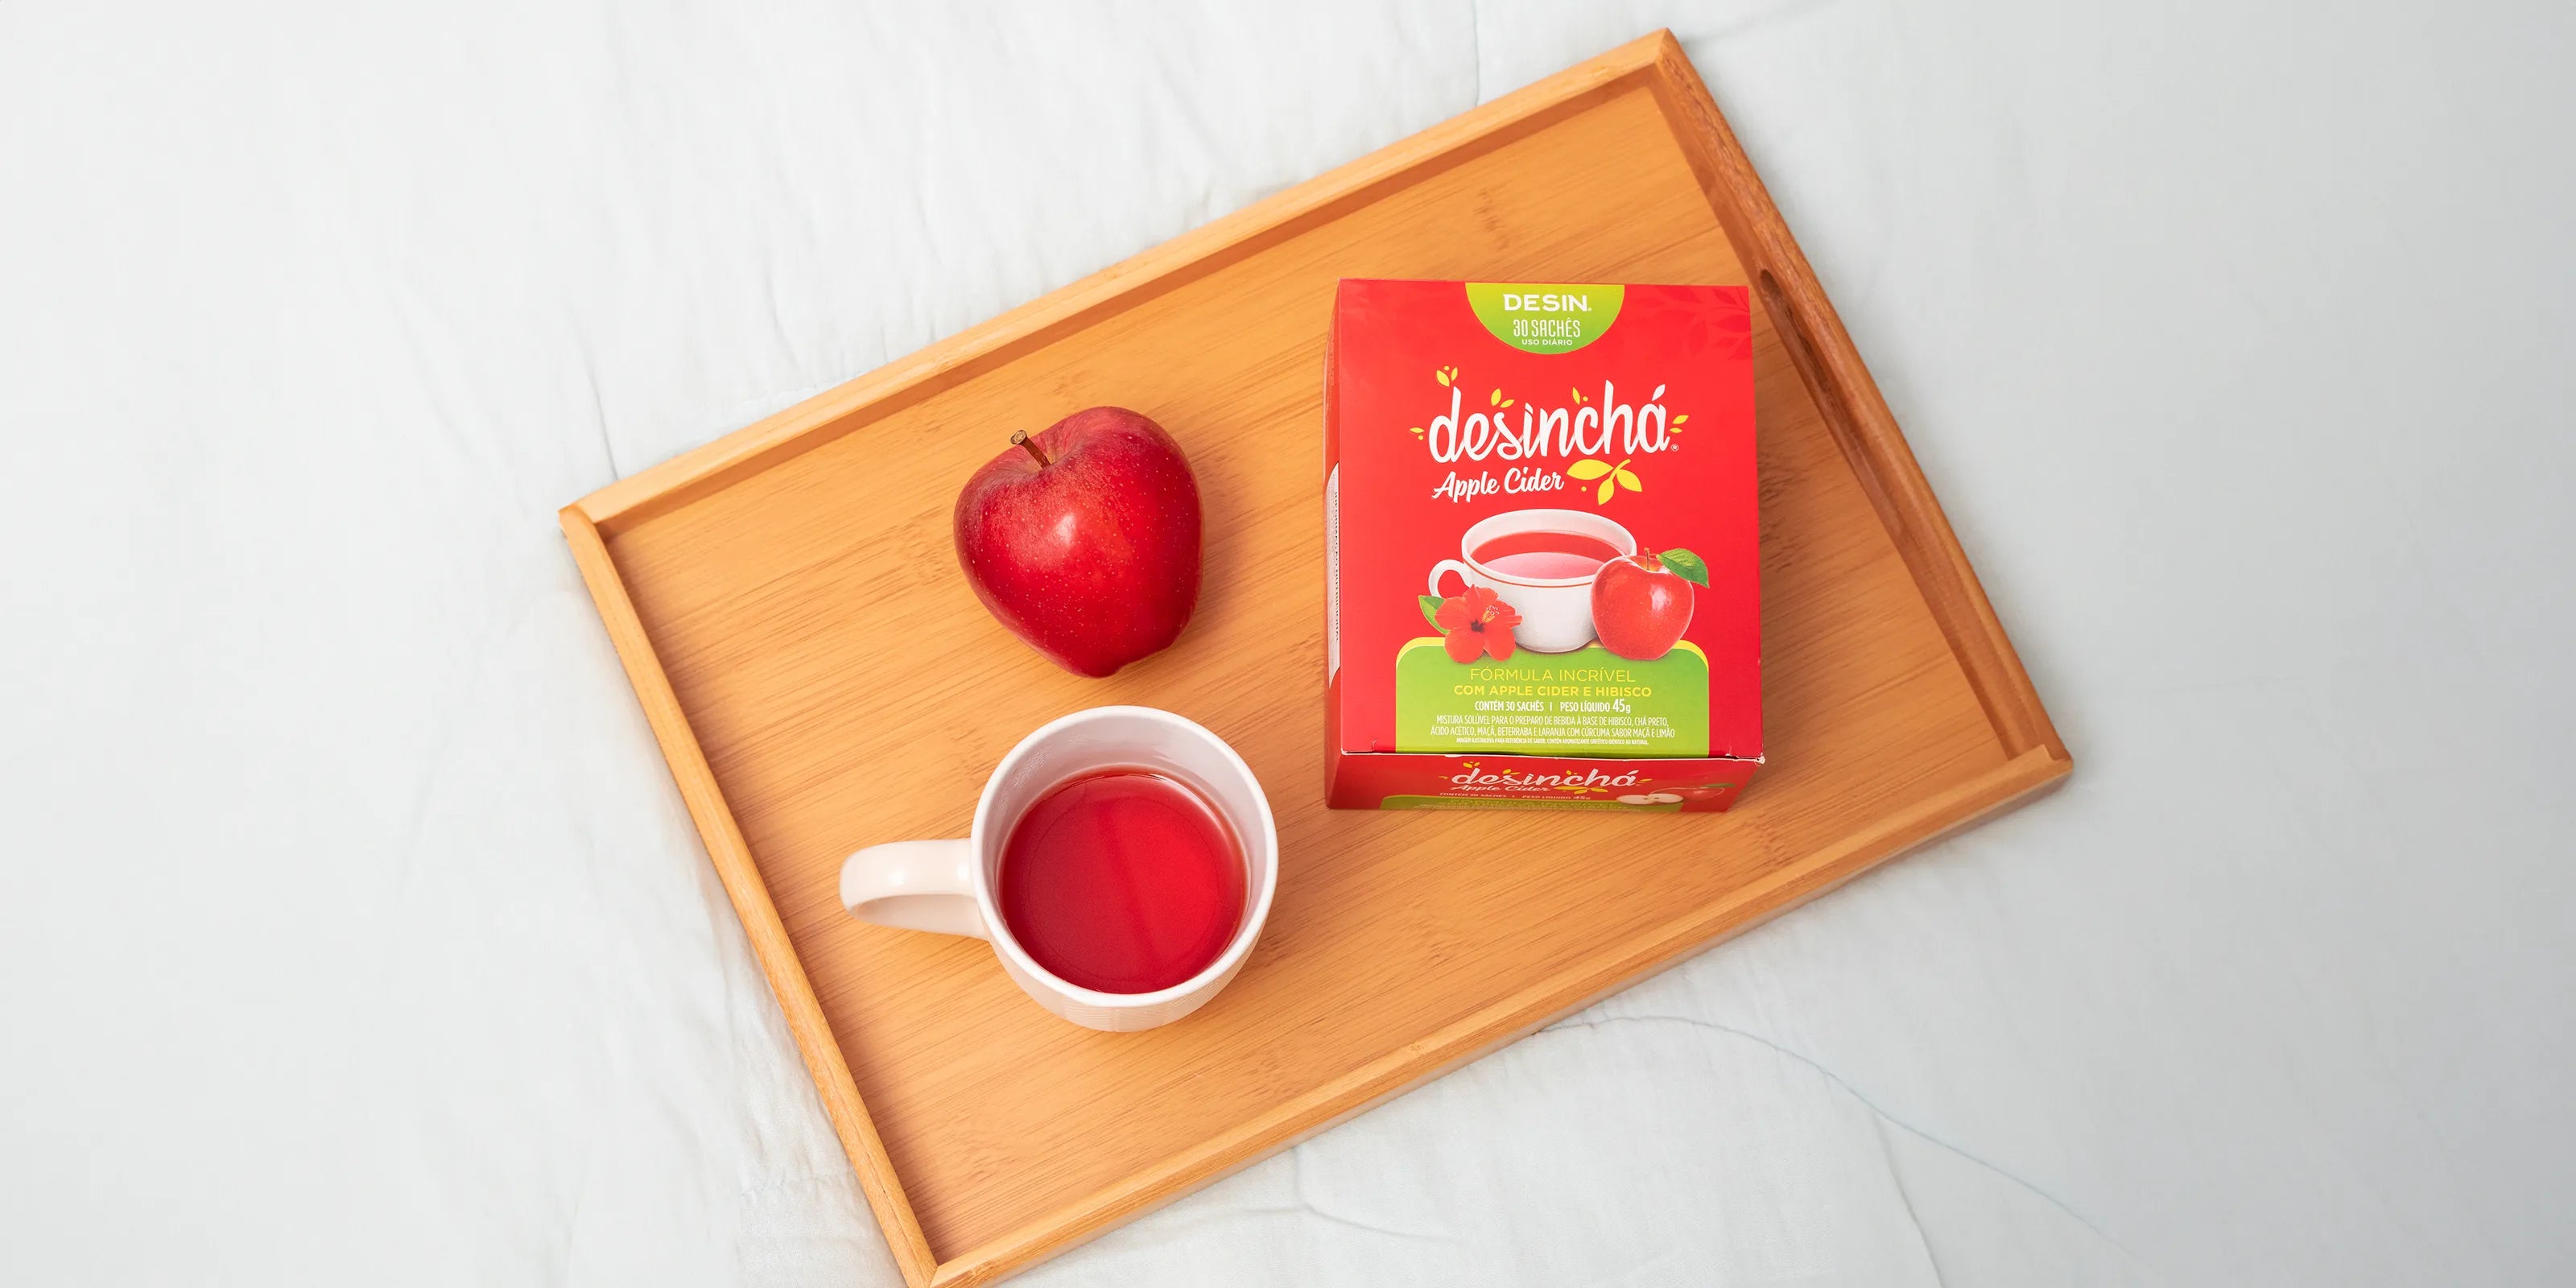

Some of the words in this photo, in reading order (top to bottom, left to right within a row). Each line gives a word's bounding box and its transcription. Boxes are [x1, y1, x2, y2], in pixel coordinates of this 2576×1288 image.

[1513, 320, 1528, 336] 30
[1531, 317, 1580, 337] SACHÊS
[1429, 379, 1670, 463] desinchá
[1431, 471, 1500, 503] Apple
[1504, 466, 1565, 494] Cider
[1471, 667, 1553, 681] FÓRMULA
[1559, 667, 1635, 683] INCRÍVEL
[1454, 686, 1484, 695] COM
[1489, 686, 1533, 696] APPLE
[1538, 686, 1579, 696] CIDER
[1583, 687, 1591, 696] E
[1596, 687, 1652, 697] HIBISCO
[1475, 700, 1504, 711] CONTÉM
[1505, 701, 1515, 711] 30
[1517, 700, 1544, 712] SACHÊS
[1560, 702, 1579, 712] PESO
[1581, 700, 1610, 712] LÍQUIDO
[1612, 699, 1630, 713] 45g
[1437, 715, 1463, 724] MISTURA
[1465, 714, 1490, 724] SOLÚVEL
[1492, 716, 1508, 724] PARA
[1509, 716, 1513, 724] O
[1516, 716, 1543, 724] PREPARO
[1545, 716, 1552, 724] DE
[1554, 716, 1575, 725] BEBIDA
[1577, 715, 1581, 725] À
[1583, 716, 1597, 725] BASE
[1600, 717, 1607, 725] DE
[1608, 717, 1633, 727] HIBISCO,
[1635, 716, 1646, 726] CHÁ
[1649, 717, 1668, 728] PRETO,
[1430, 726, 1449, 735] ÁCIDO
[1451, 725, 1476, 737] ACÉTICO,
[1478, 726, 1496, 737] MAÇÃ,
[1498, 727, 1532, 736] BETERRABA
[1534, 728, 1538, 736] E
[1539, 728, 1566, 737] LARANJA
[1567, 728, 1579, 737] COM
[1581, 727, 1610, 737] CÚRCUMA
[1612, 729, 1631, 737] SABOR
[1633, 727, 1649, 738] MAÇÃ
[1651, 729, 1655, 737] E
[1657, 728, 1674, 737] LIMÃO
[1451, 767, 1639, 786] desinchá
